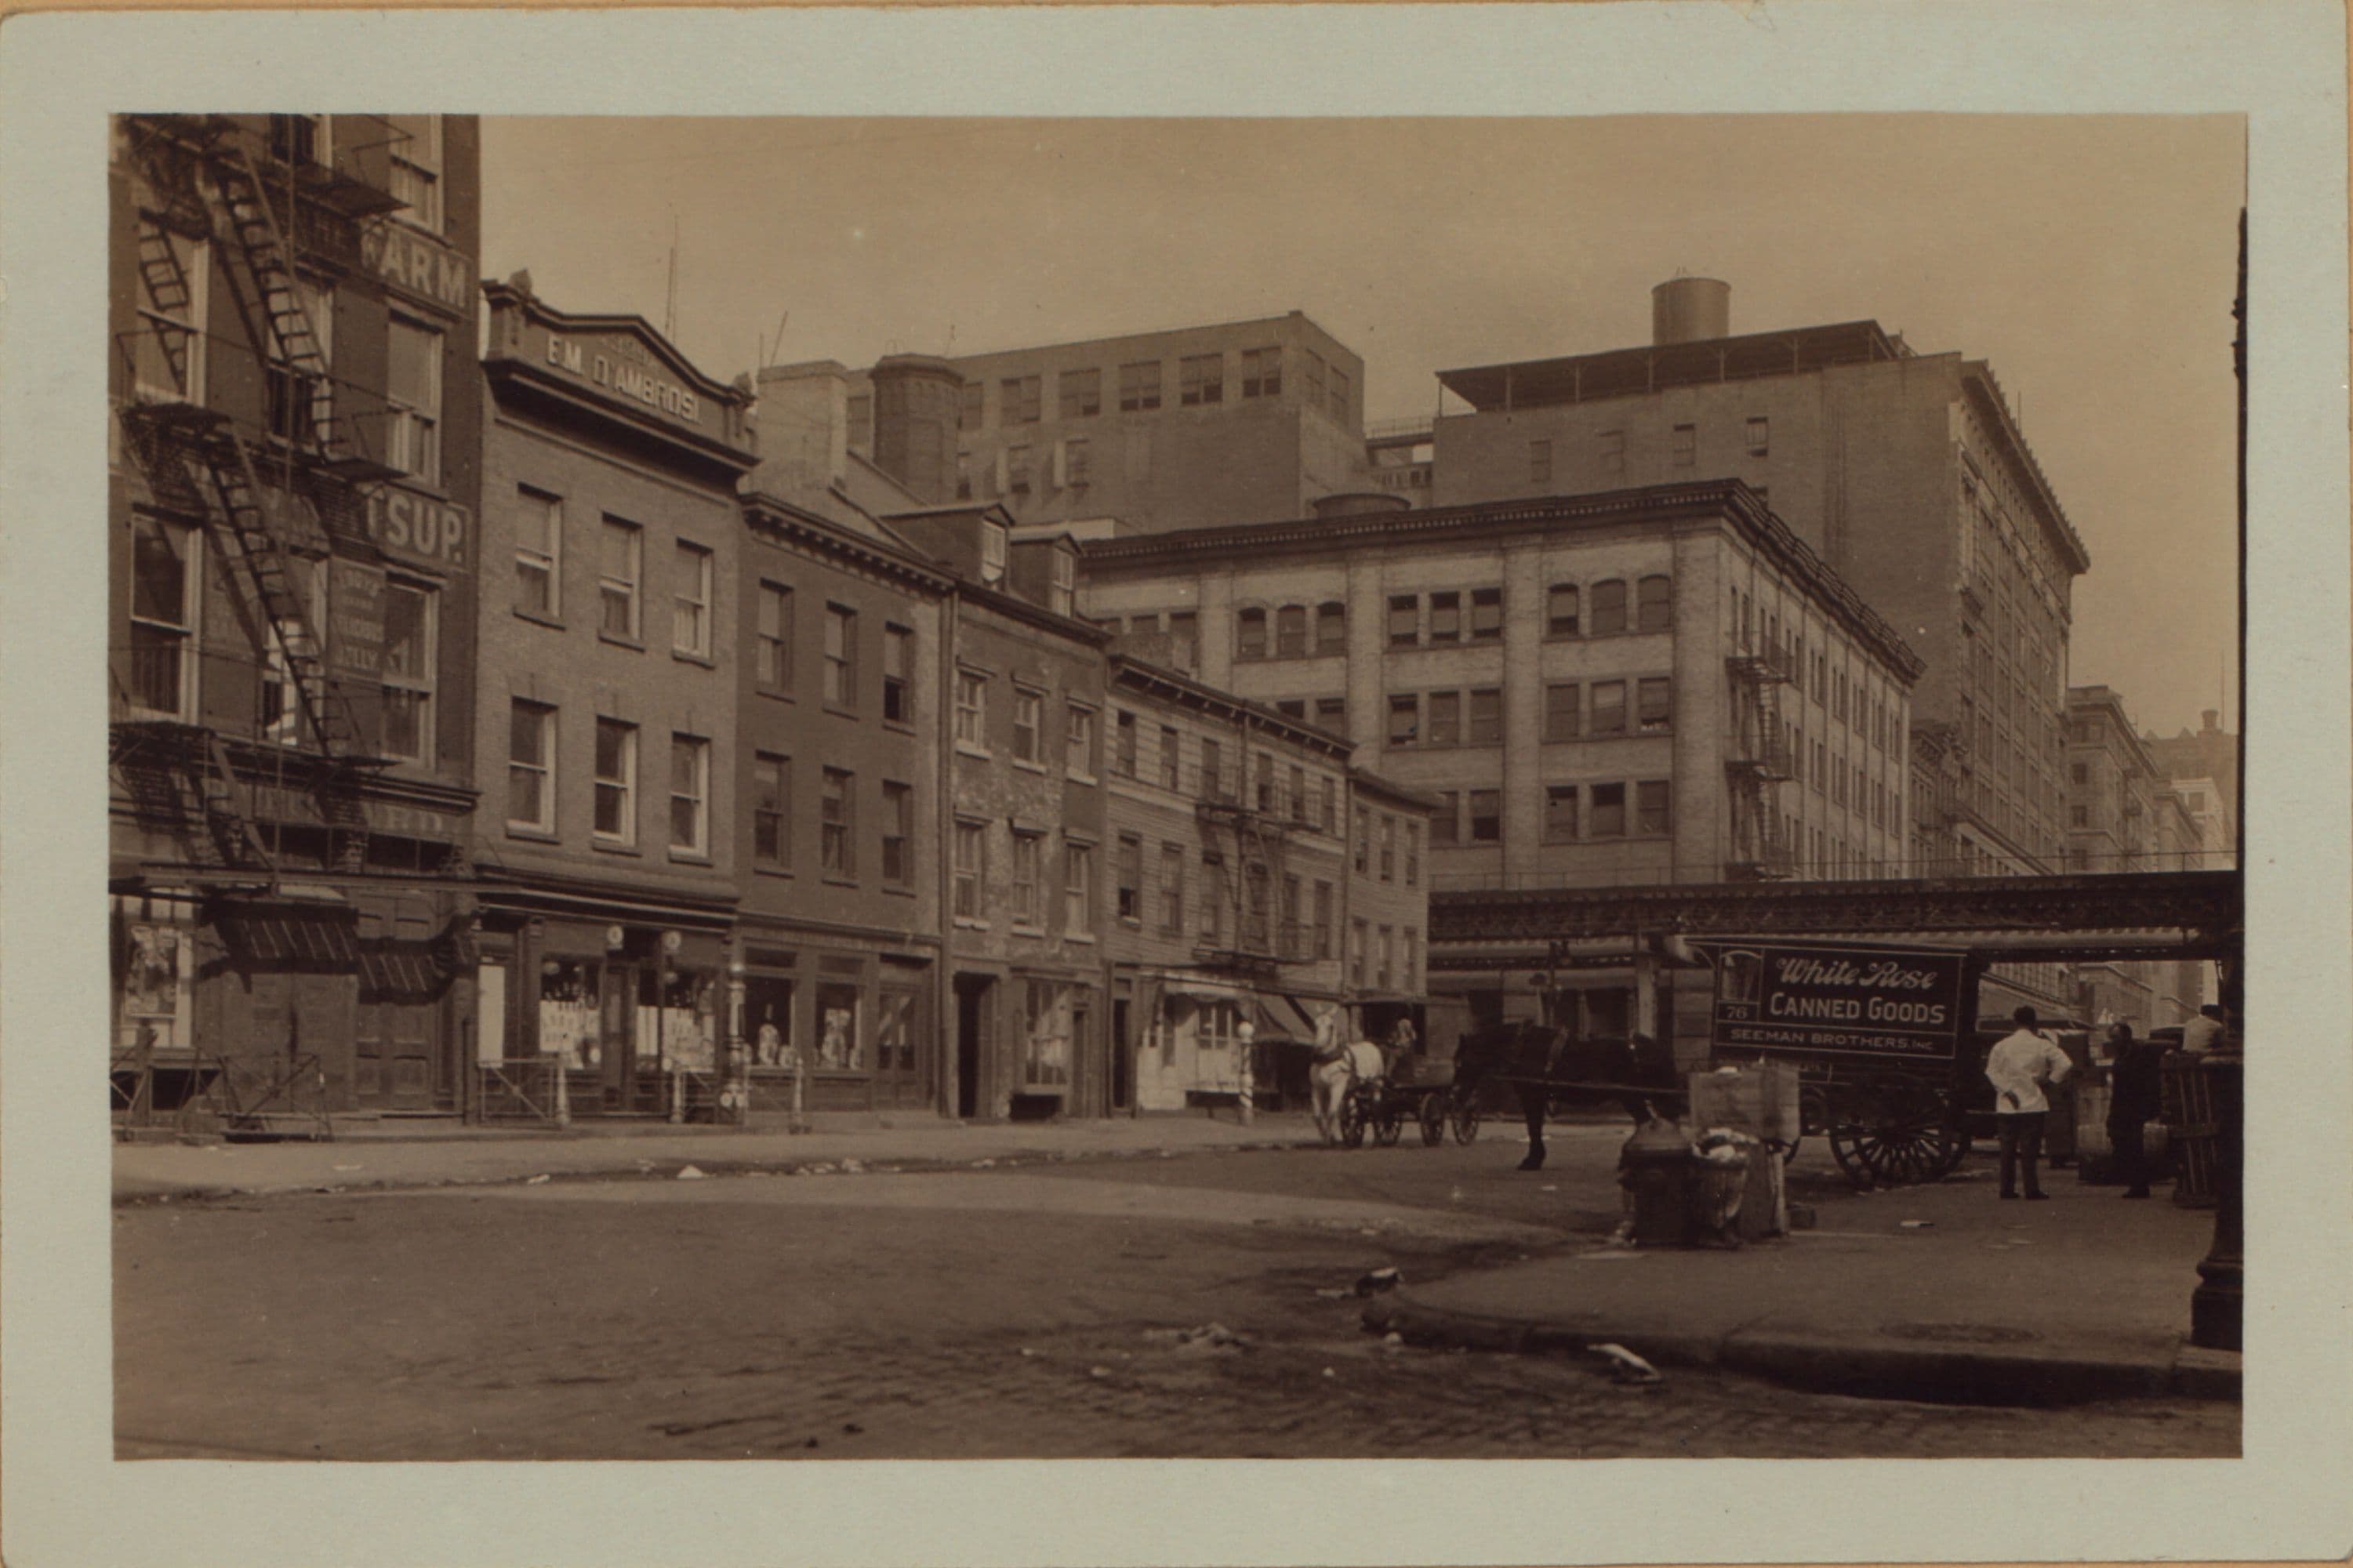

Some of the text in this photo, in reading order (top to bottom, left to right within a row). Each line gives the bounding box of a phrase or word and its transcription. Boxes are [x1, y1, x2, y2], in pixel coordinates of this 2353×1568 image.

[1776, 957, 1938, 990] White Rose
[1727, 1005, 1748, 1020] 76
[1770, 991, 1946, 1025] CANNED GOODS
[1730, 1028, 1804, 1043] SEEMAN
